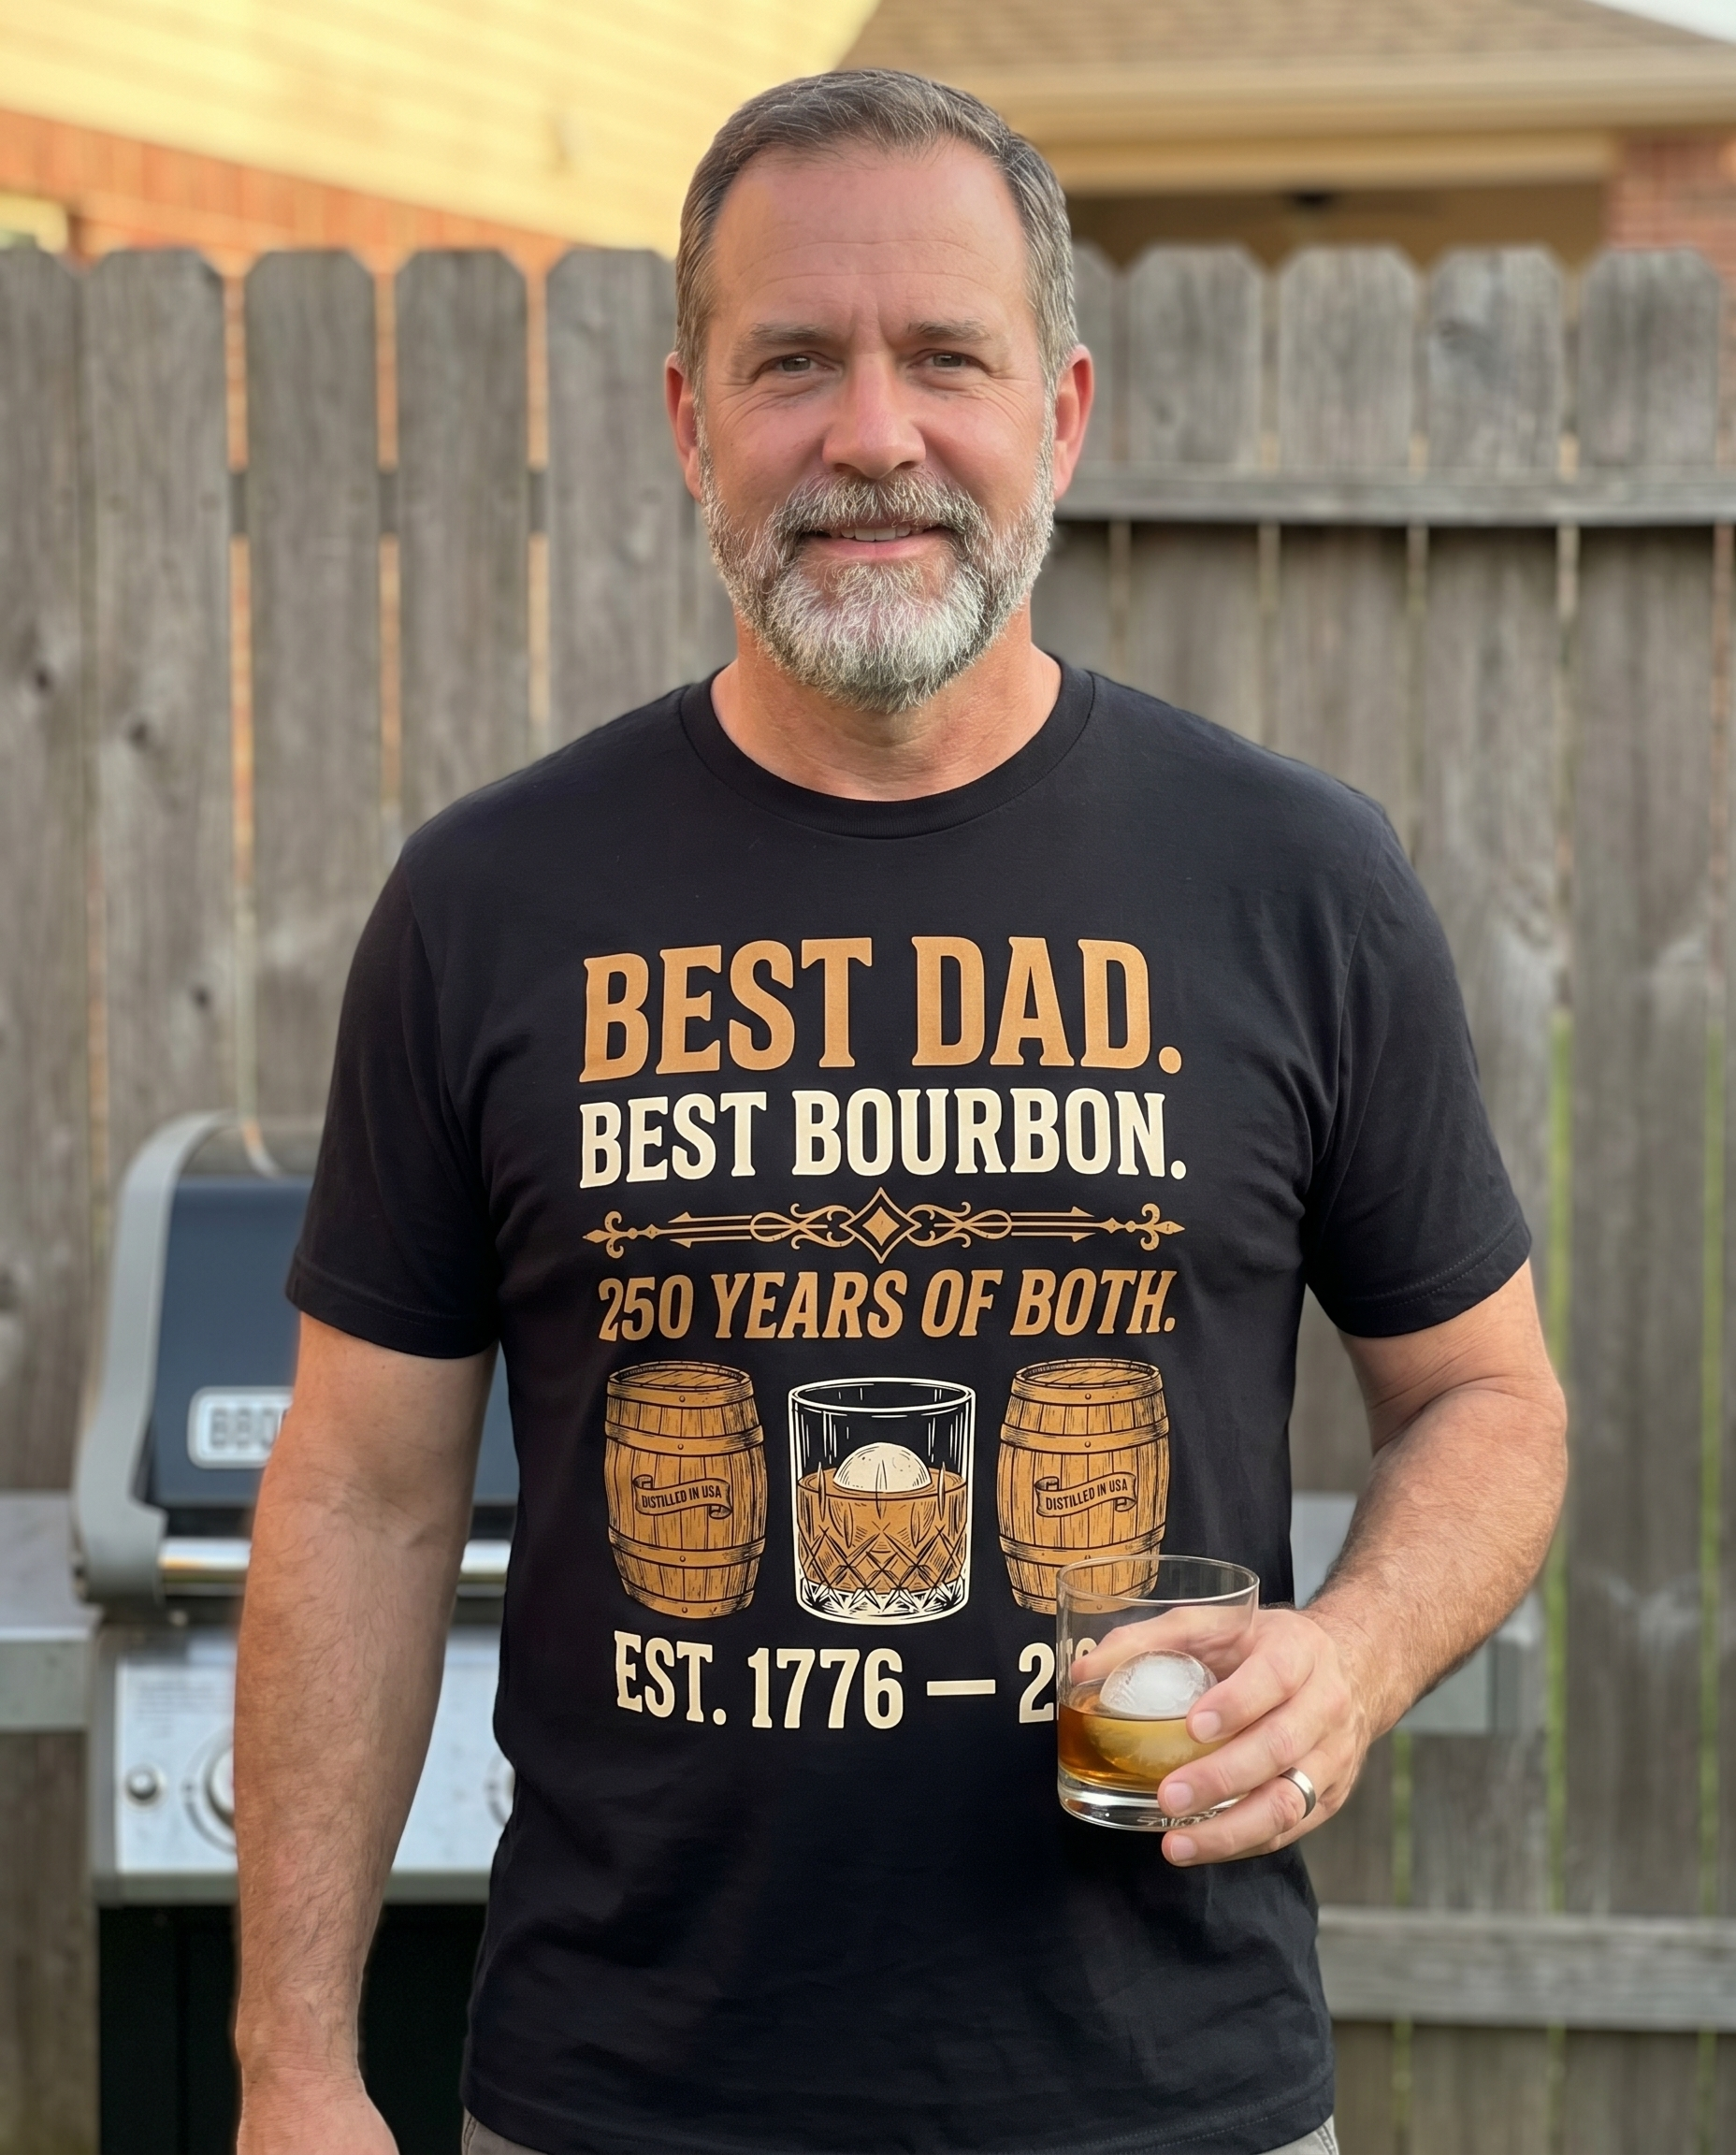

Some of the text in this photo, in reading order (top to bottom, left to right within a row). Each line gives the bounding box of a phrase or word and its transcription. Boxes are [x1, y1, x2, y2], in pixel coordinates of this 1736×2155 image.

[579, 936, 1182, 1082] BEST DAD.
[579, 1088, 1186, 1188] BEST BOURBON.
[599, 1268, 1178, 1342] 250 YEARS OF BOTH.
[642, 1485, 722, 1508] DISTILLED IN USA
[1046, 1479, 1128, 1510] DISTILLED IN USA
[614, 1630, 727, 1725] EST.
[748, 1647, 904, 1728] 1776
